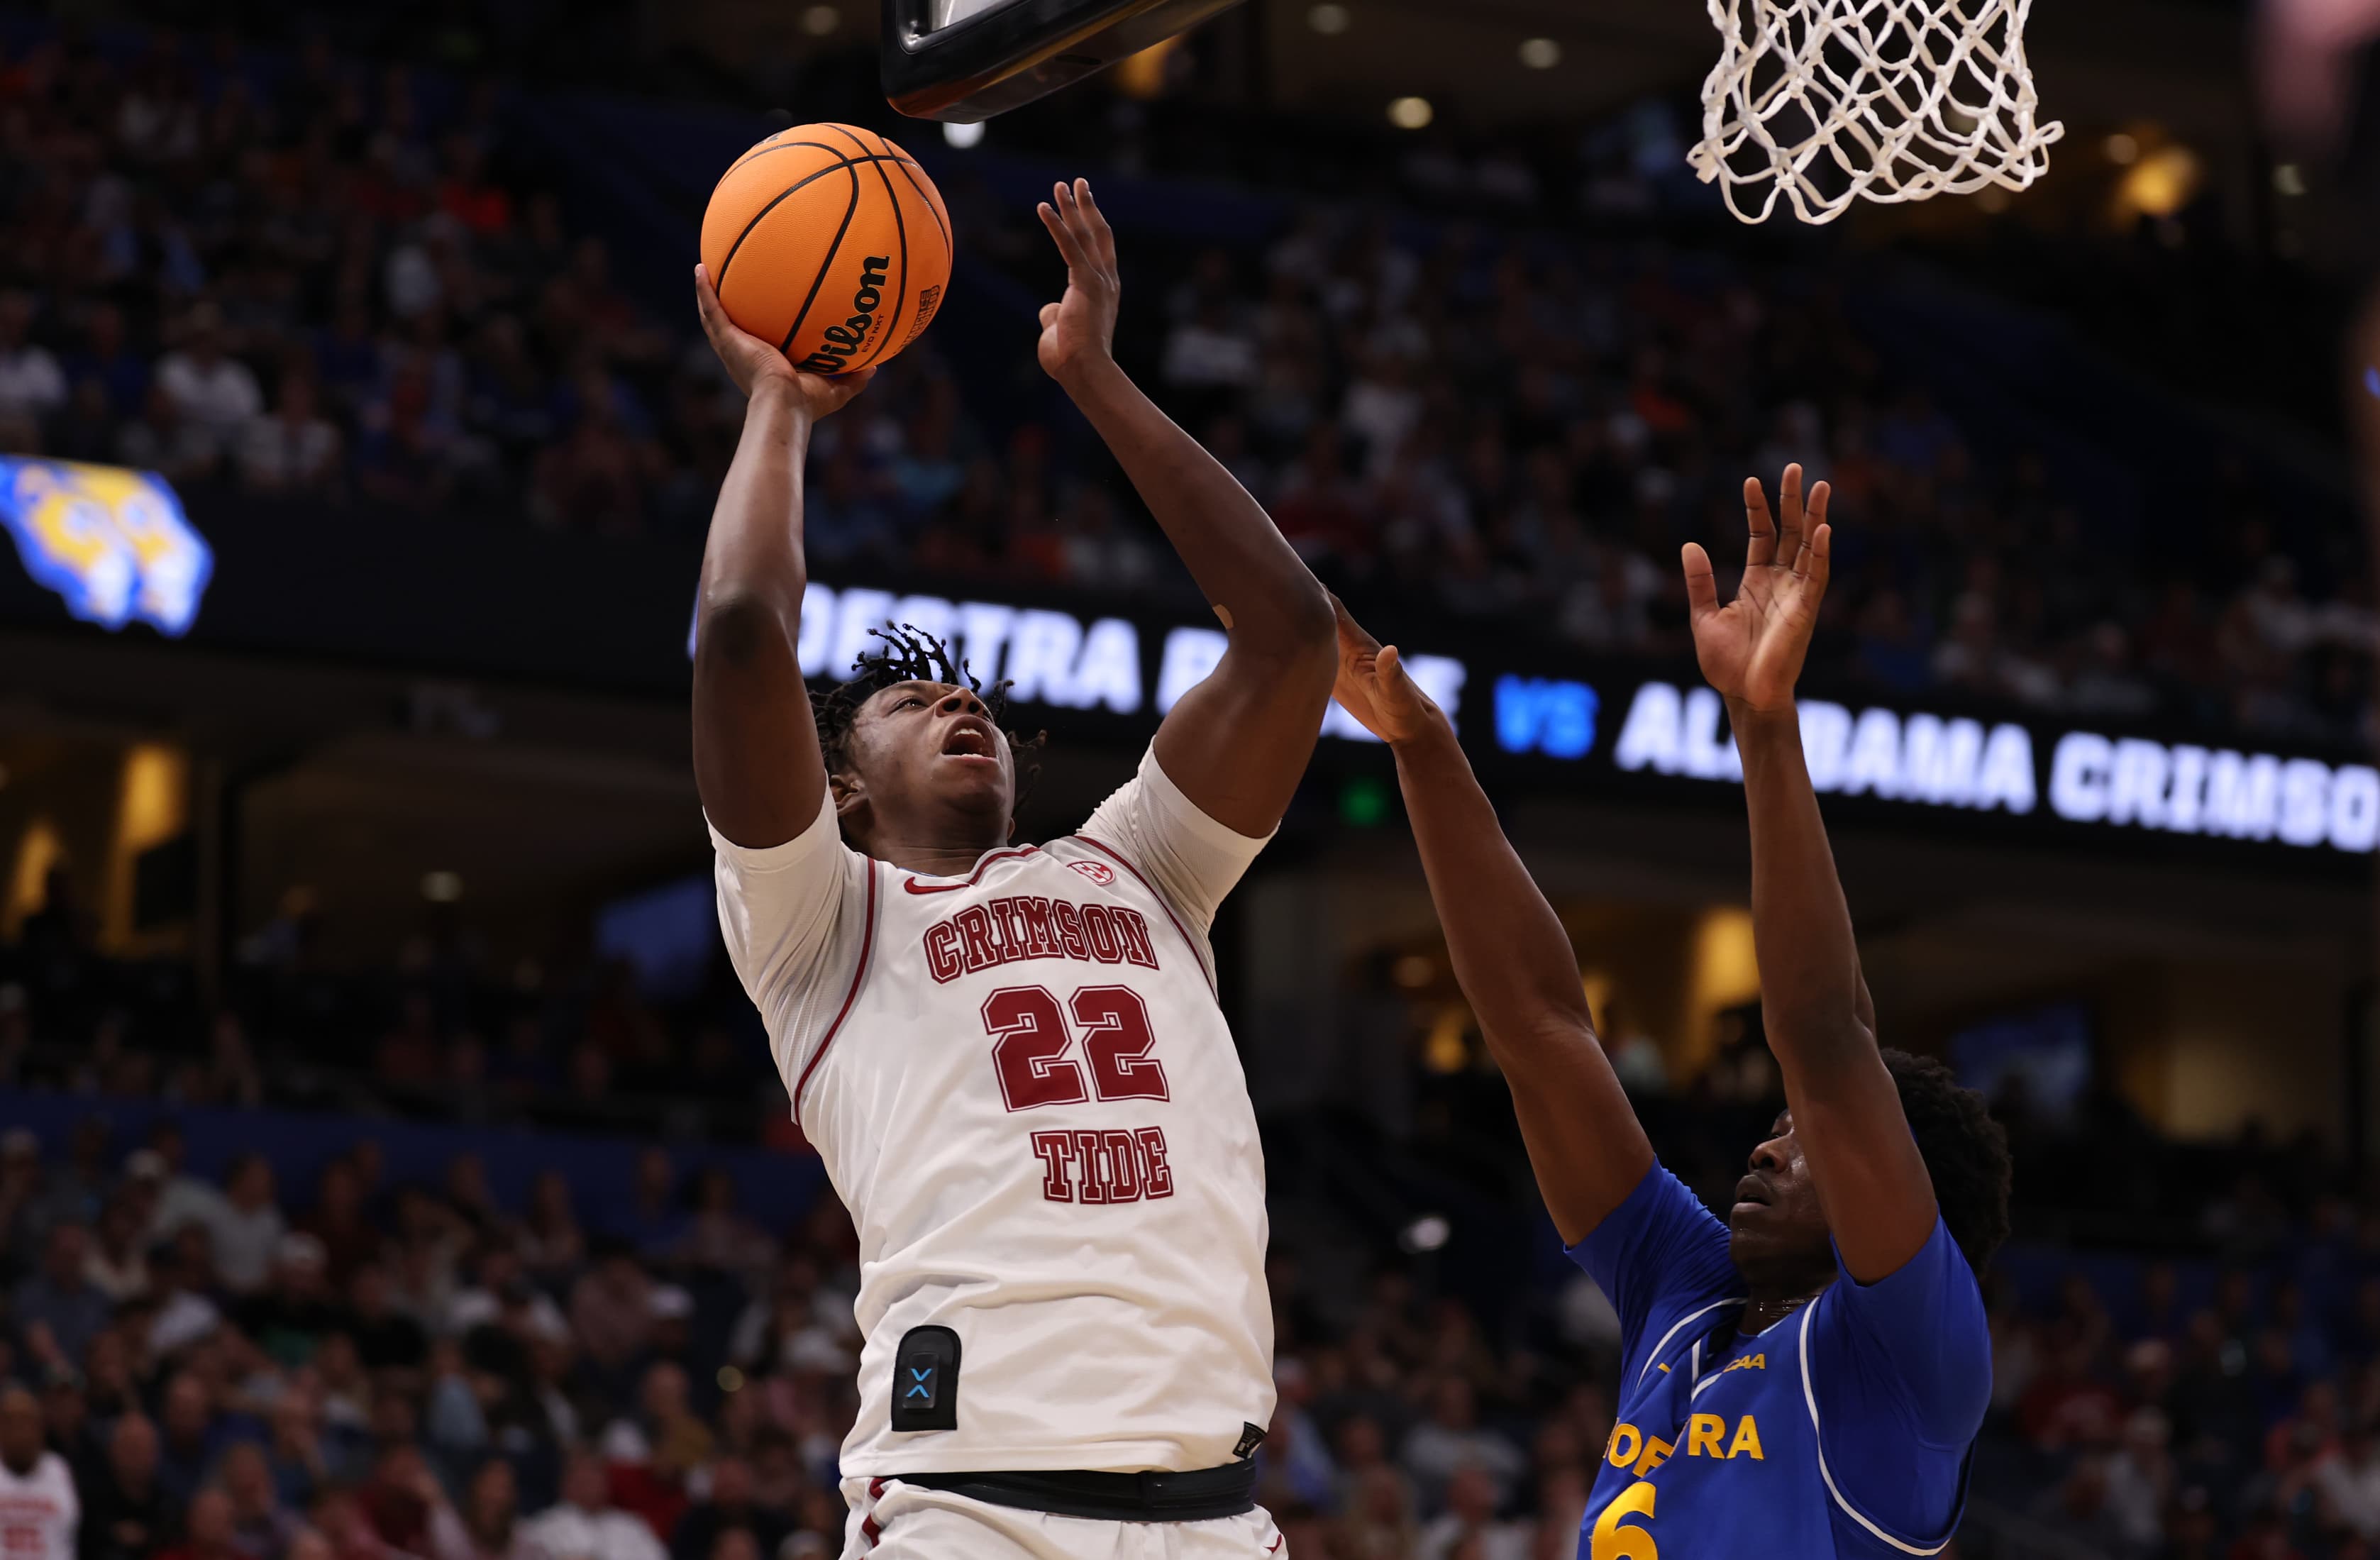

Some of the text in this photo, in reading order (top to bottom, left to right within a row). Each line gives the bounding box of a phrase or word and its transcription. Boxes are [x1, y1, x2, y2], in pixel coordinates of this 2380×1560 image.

[795, 255, 890, 375] Wilson
[861, 314, 885, 353] EVO NXT
[1493, 674, 1600, 759] VS
[1615, 681, 2036, 815] ALBAMA
[923, 896, 1160, 985] CRIMSON
[980, 985, 1170, 1112] 22
[1030, 1126, 1173, 1205] TIDE
[1590, 1481, 1659, 1560] 6
